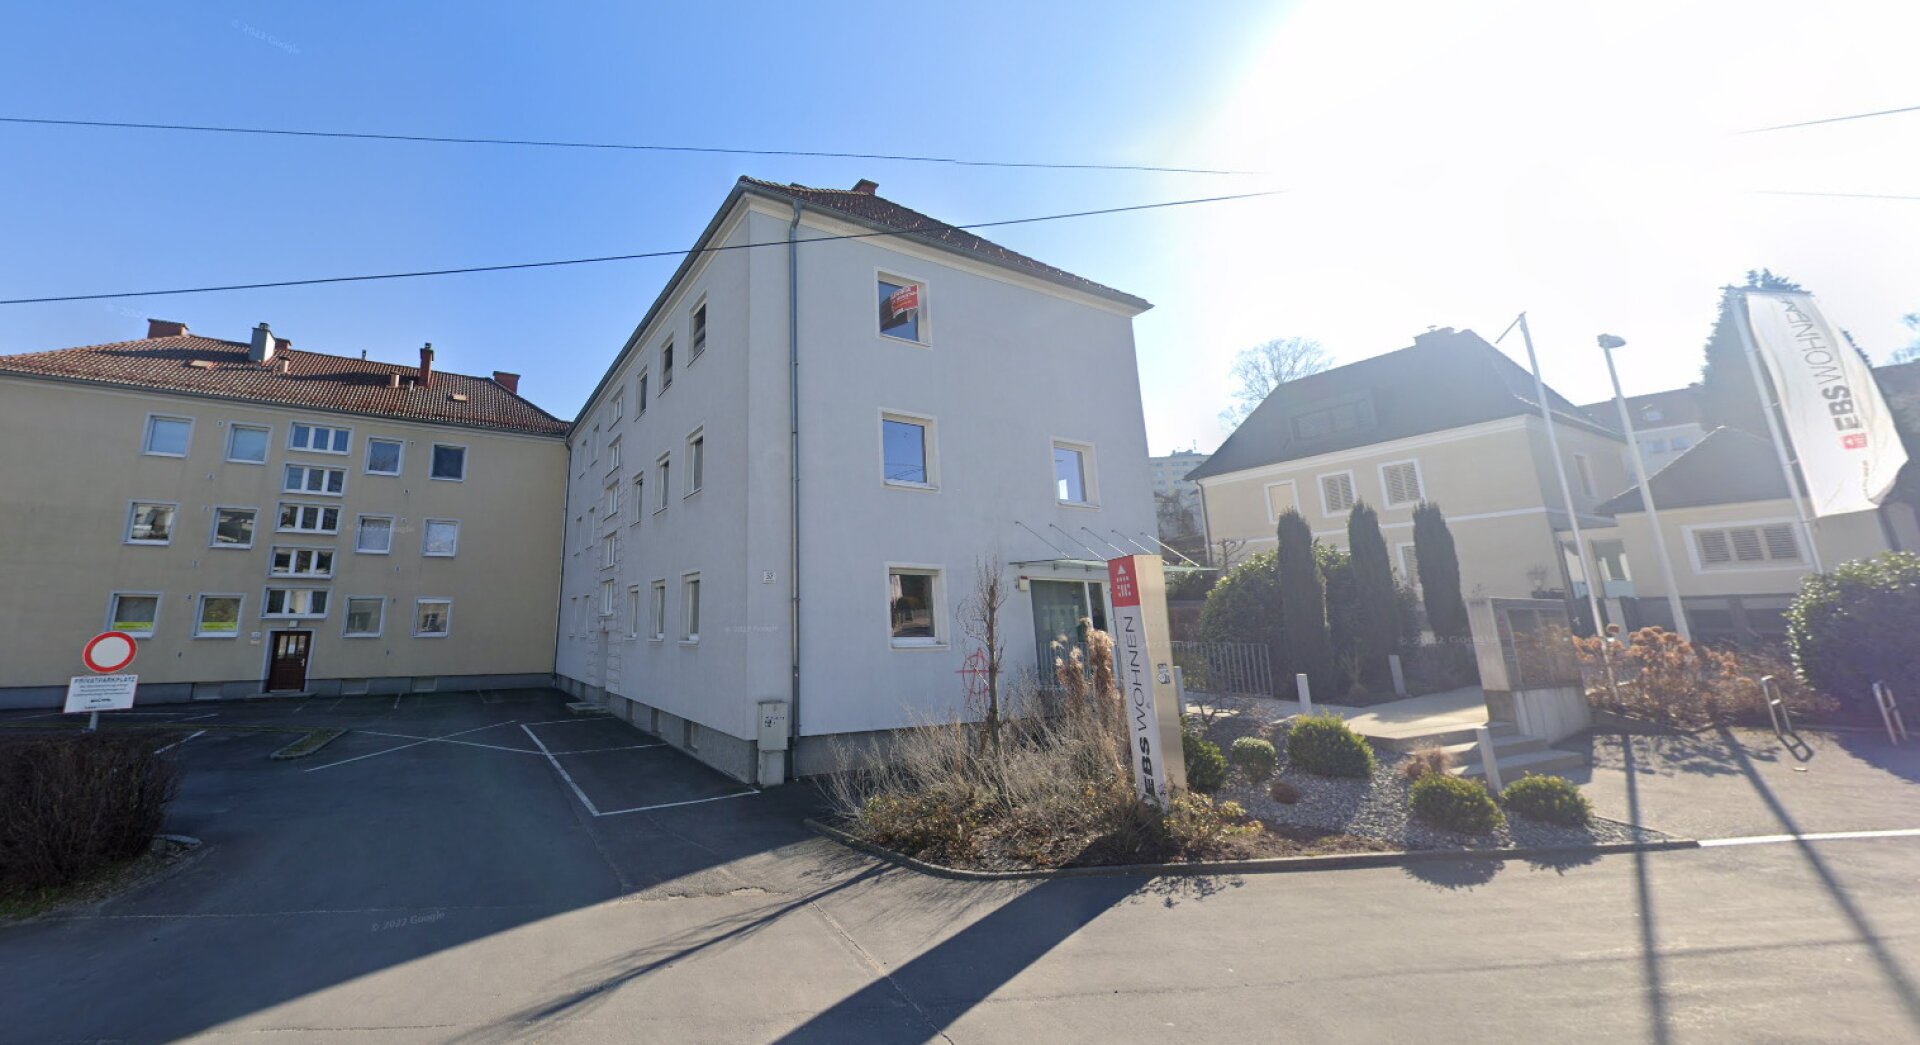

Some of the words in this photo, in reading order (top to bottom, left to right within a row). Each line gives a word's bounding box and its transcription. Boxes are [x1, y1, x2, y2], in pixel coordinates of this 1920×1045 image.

[1782, 299, 1843, 385] WOHNEN
[1822, 385, 1861, 431] EBS
[1123, 616, 1147, 732] WOHNEN
[1139, 737, 1156, 797] EBS
